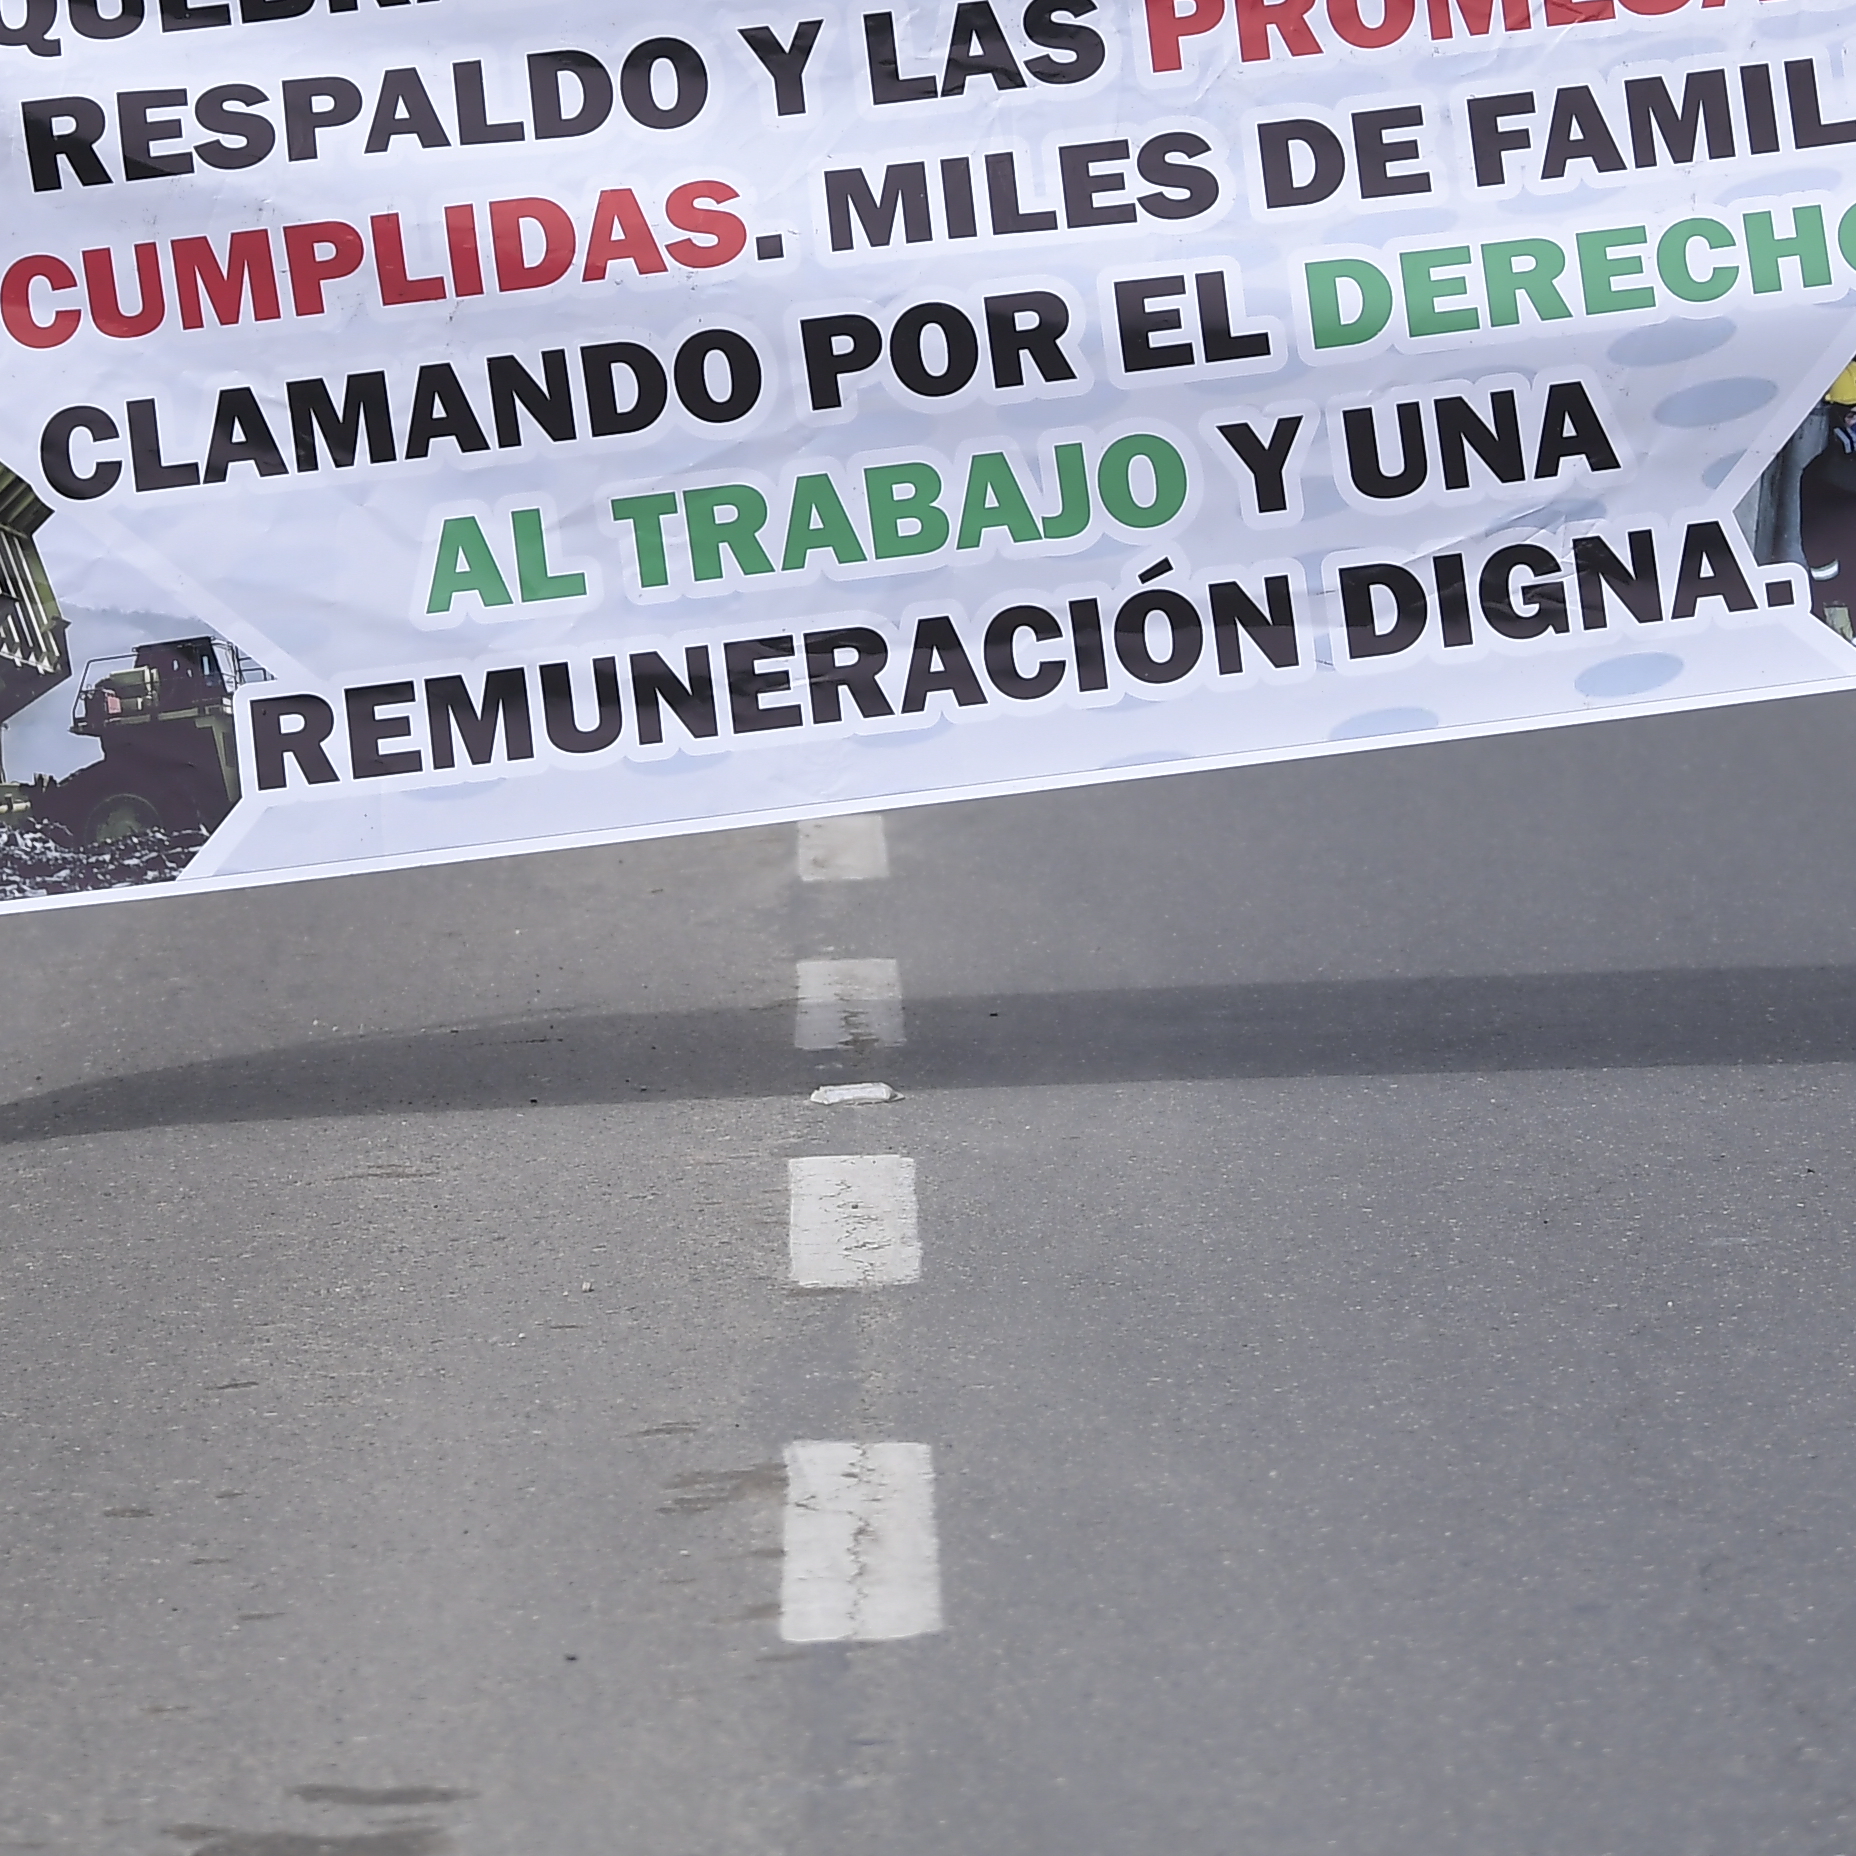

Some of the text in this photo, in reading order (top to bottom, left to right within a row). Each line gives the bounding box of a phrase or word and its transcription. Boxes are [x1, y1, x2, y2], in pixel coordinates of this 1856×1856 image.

[21, 37, 708, 192] RESPALDO
[738, 19, 823, 116] Y
[824, 132, 1219, 251] MILES
[1257, 105, 1431, 209] DE
[41, 329, 761, 500] CLAMANDO
[800, 291, 1077, 410] POR
[1114, 271, 1271, 373] EL
[427, 381, 1621, 613] AL TRABAJO Y UNA
[250, 521, 1794, 790] REMUNERACIÓN DIGNA.
